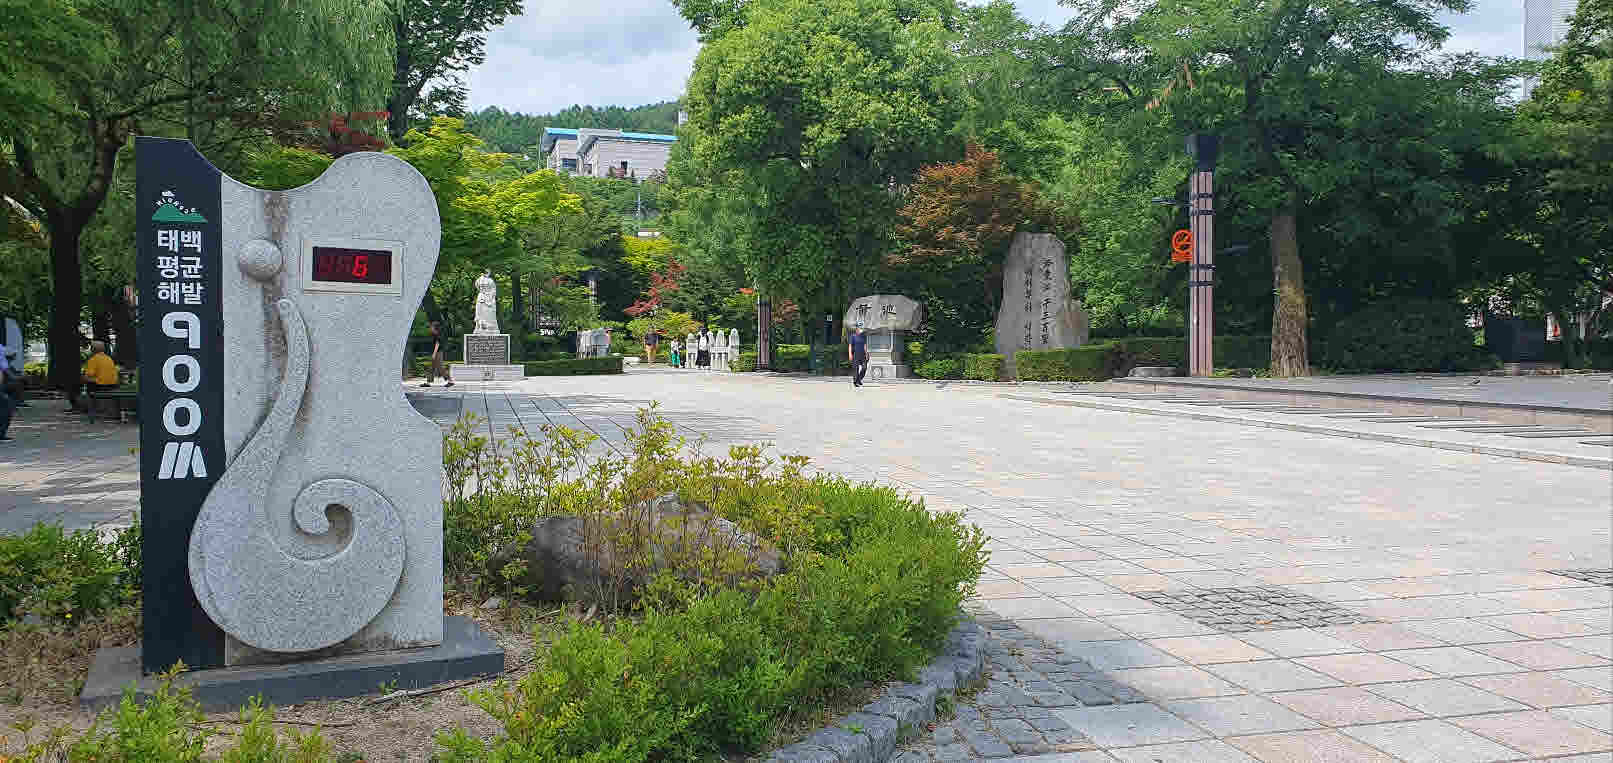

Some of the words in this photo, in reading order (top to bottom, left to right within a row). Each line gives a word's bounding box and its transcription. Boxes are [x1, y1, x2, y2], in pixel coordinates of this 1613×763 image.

[157, 229, 202, 253] 태백
[157, 256, 203, 279] 평균
[157, 281, 203, 305] 해발
